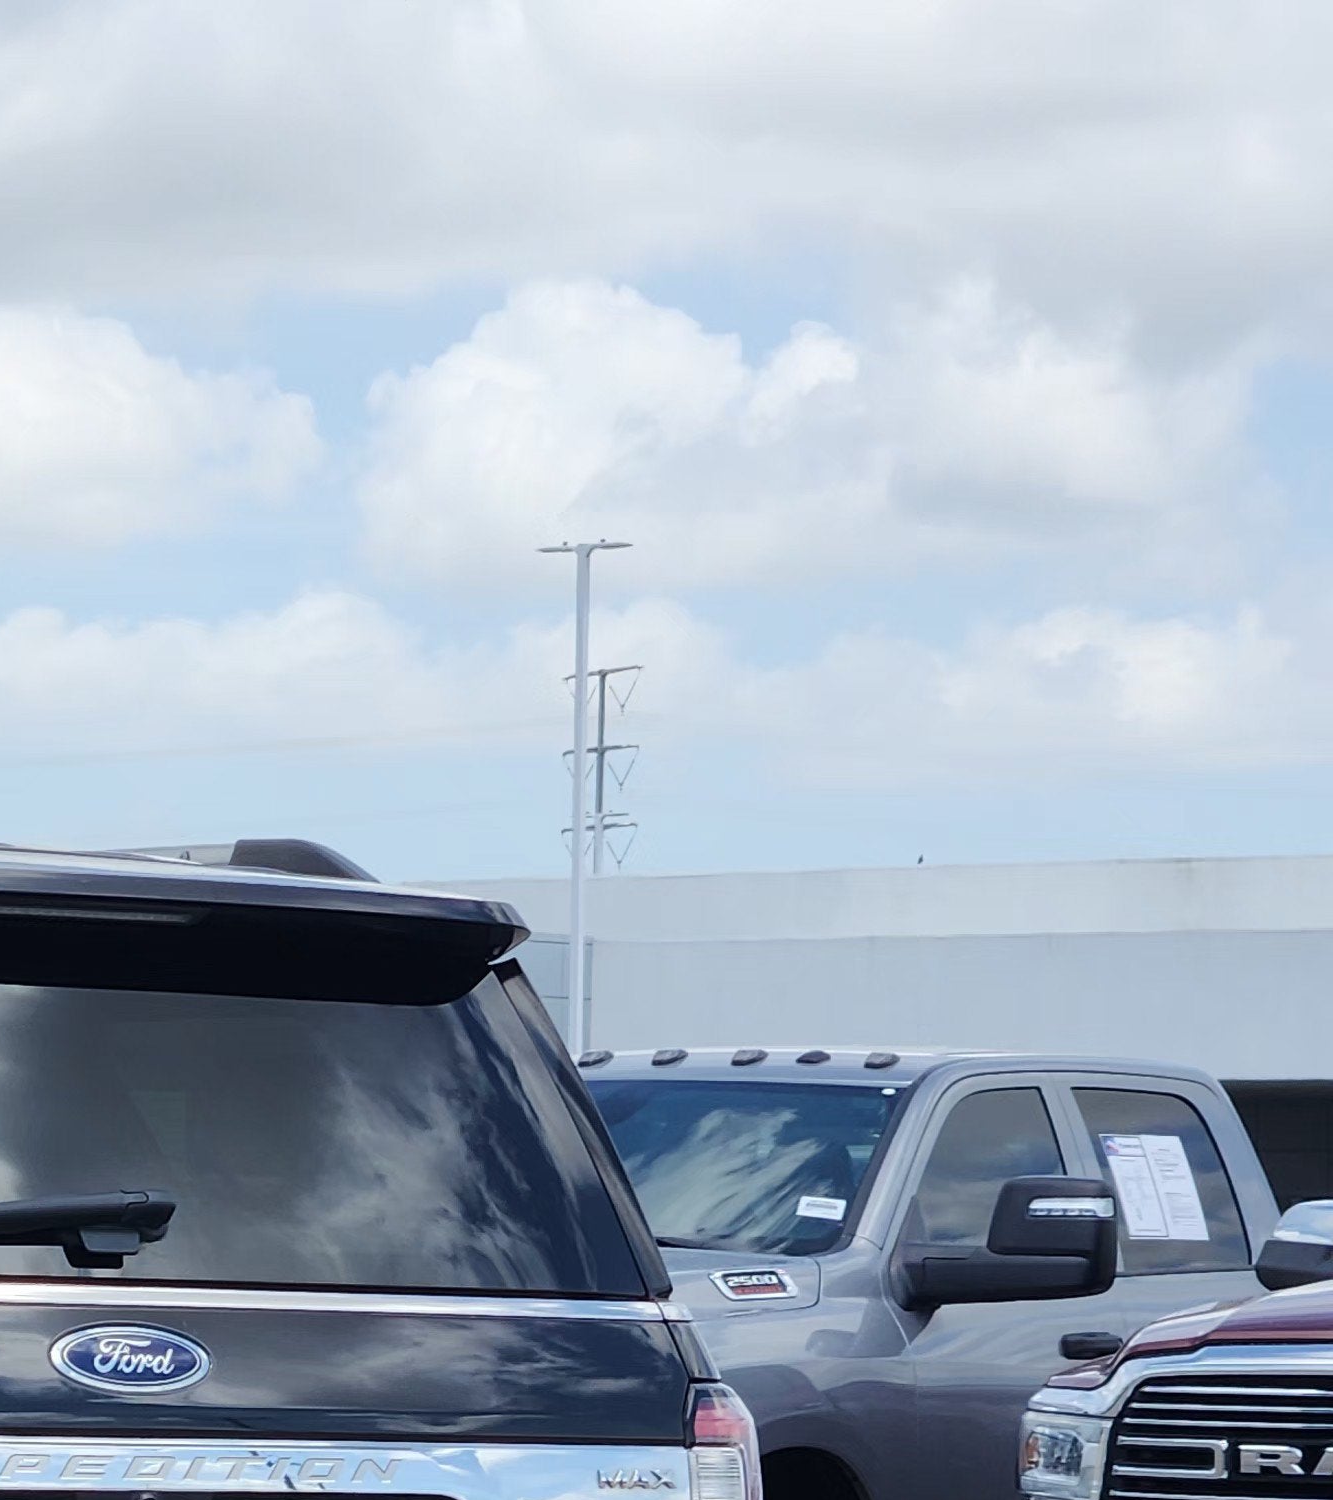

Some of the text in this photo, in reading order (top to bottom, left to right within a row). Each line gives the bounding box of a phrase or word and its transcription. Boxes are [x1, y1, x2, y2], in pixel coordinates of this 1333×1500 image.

[726, 1274, 779, 1287] 2500
[93, 1337, 175, 1375] Ford
[597, 1469, 677, 1489] MAX
